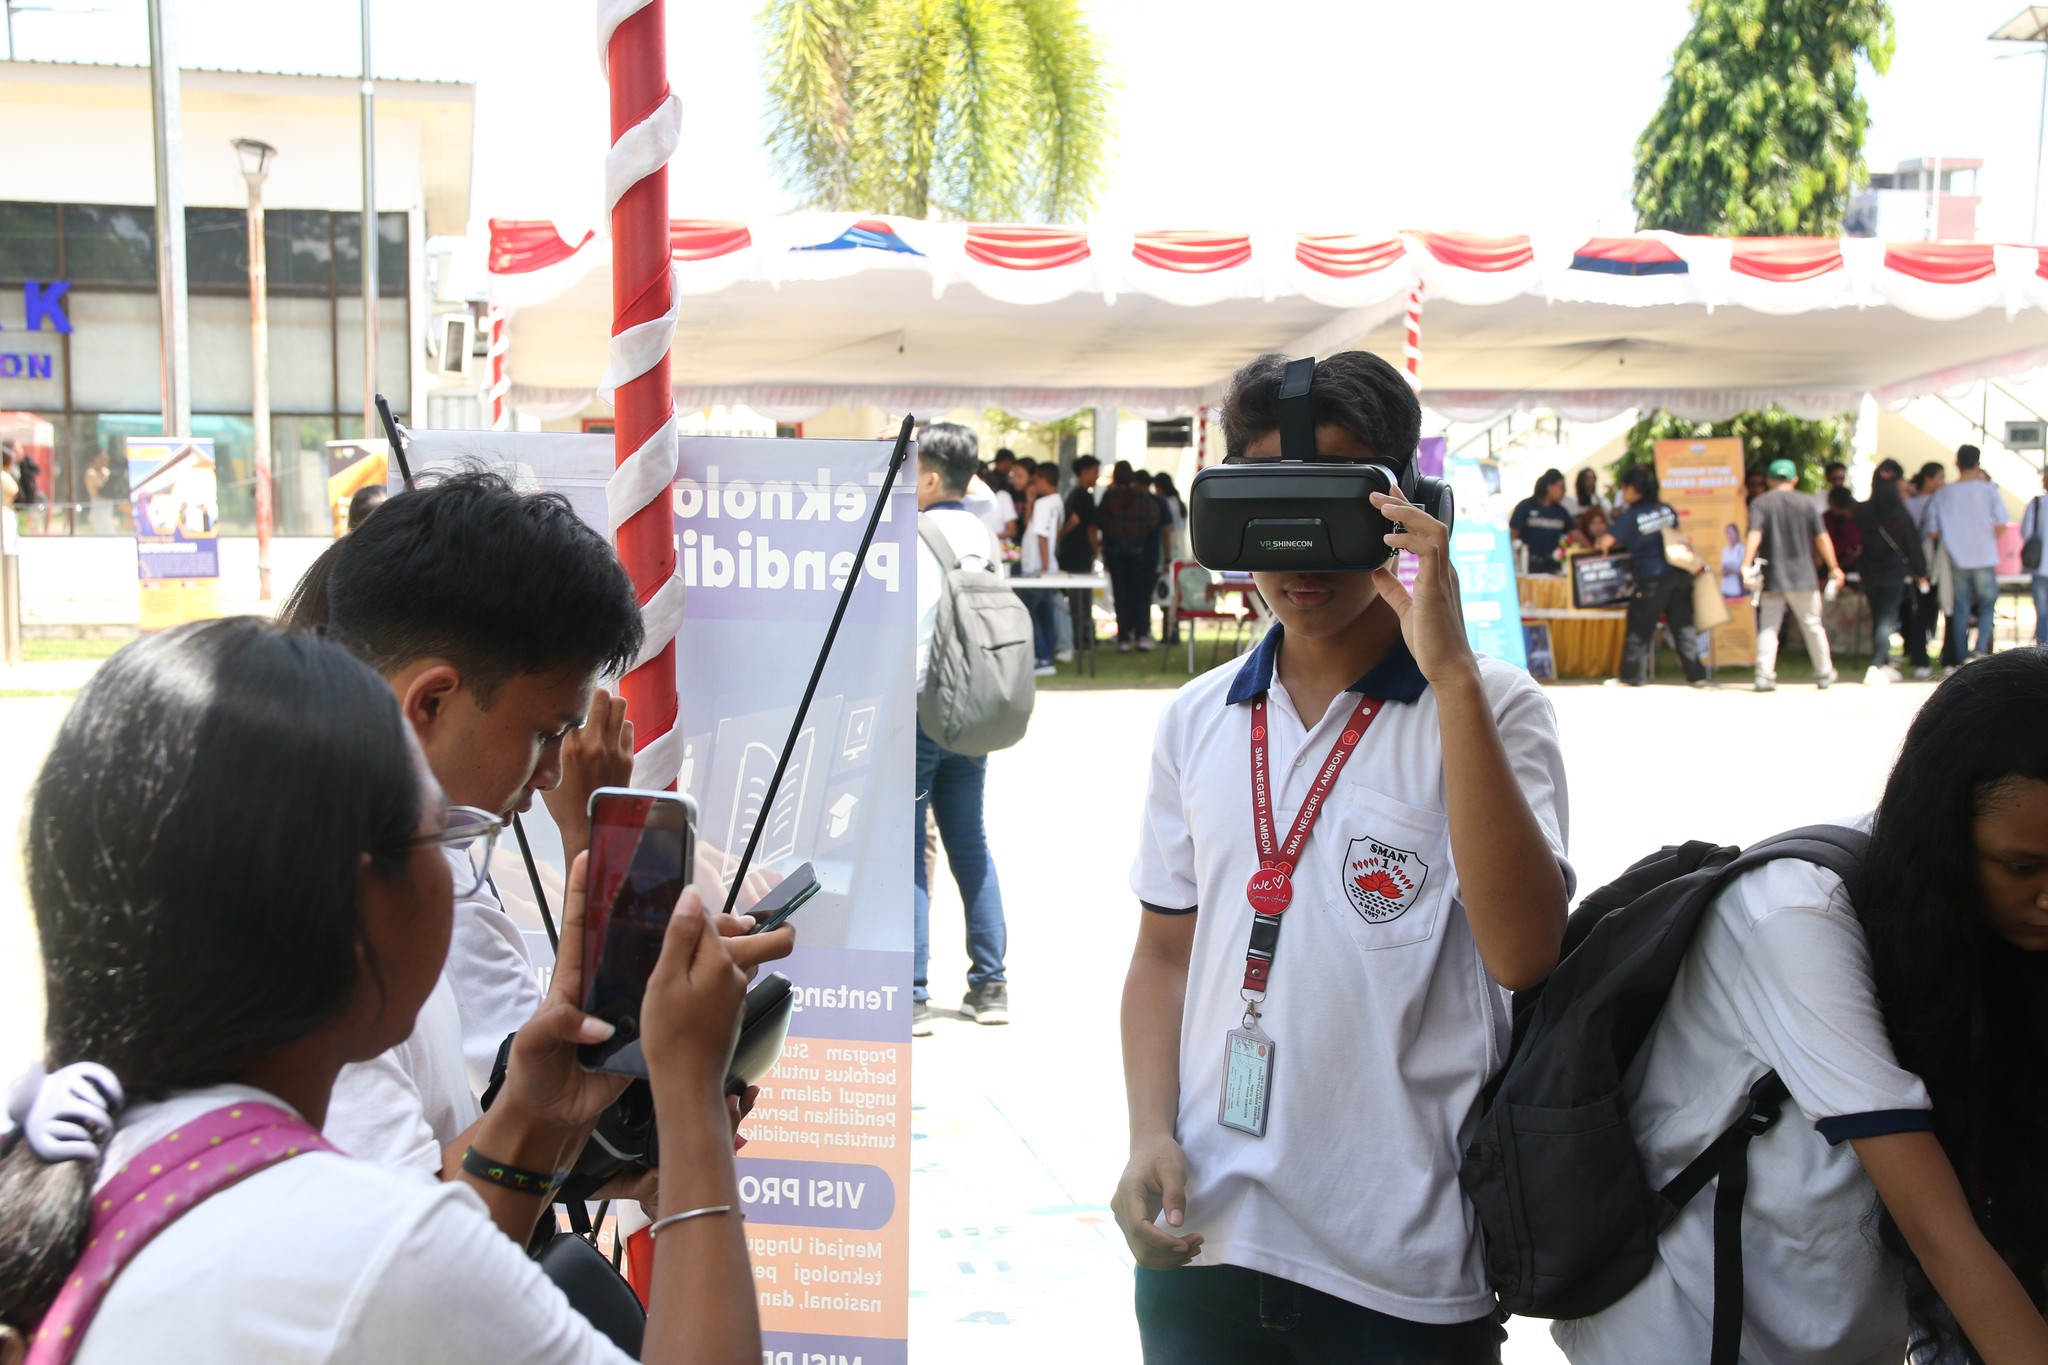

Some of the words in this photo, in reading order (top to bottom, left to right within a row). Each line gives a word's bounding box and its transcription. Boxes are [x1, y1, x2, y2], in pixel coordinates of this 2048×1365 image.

[0, 279, 74, 334] K
[1260, 540, 1271, 548] VR
[1273, 540, 1313, 548] SHINECON
[1255, 747, 1263, 769] SMA
[1256, 770, 1265, 808] NEGERI
[1286, 834, 1303, 856] SMA
[1298, 794, 1321, 833] NEGERI
[1320, 750, 1345, 786] AMBON
[1259, 817, 1272, 855] AMBON
[1370, 843, 1408, 864] SMAN
[1381, 859, 1389, 869] 1
[1252, 880, 1273, 890] we
[1358, 902, 1387, 917] AMBON
[1364, 909, 1379, 919] 1957
